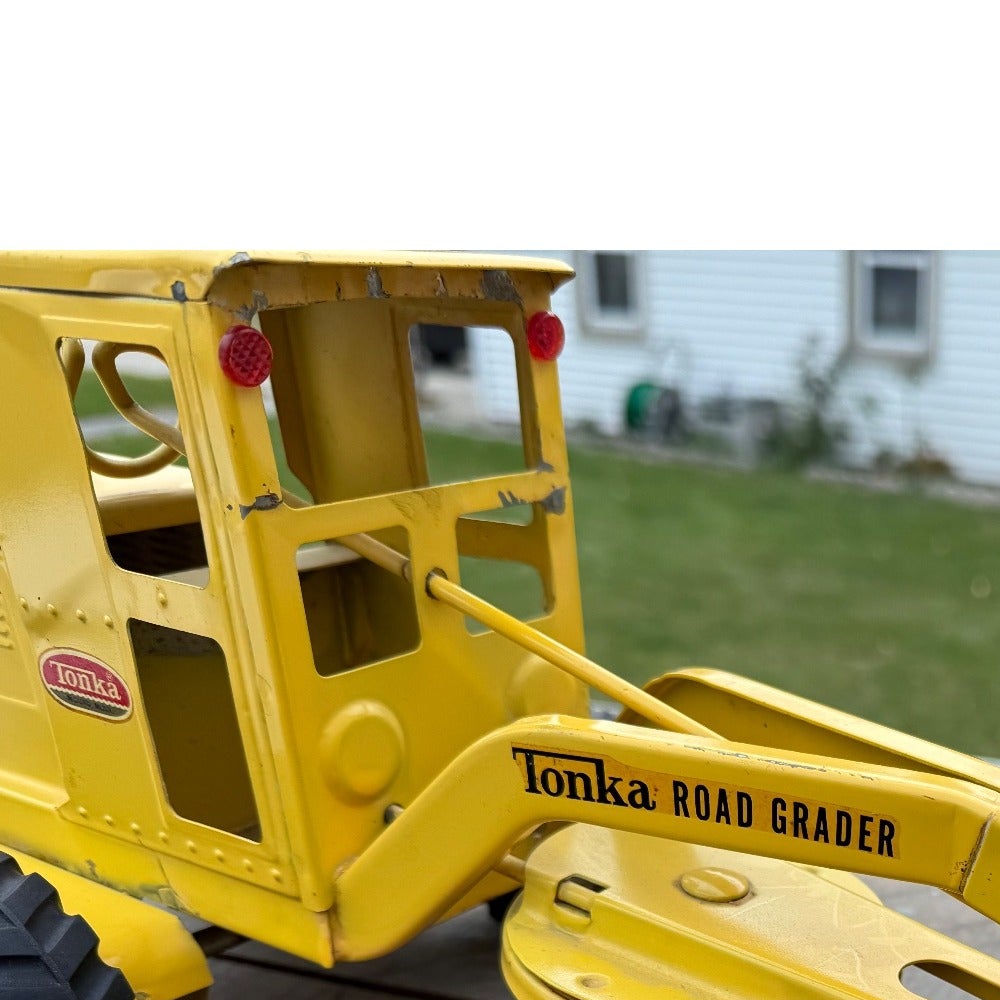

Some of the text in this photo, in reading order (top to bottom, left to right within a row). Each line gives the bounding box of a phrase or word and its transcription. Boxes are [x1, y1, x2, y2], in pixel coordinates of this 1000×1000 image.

[49, 659, 122, 701] Tonka
[511, 746, 896, 858] Tonka ROAD GRADER
